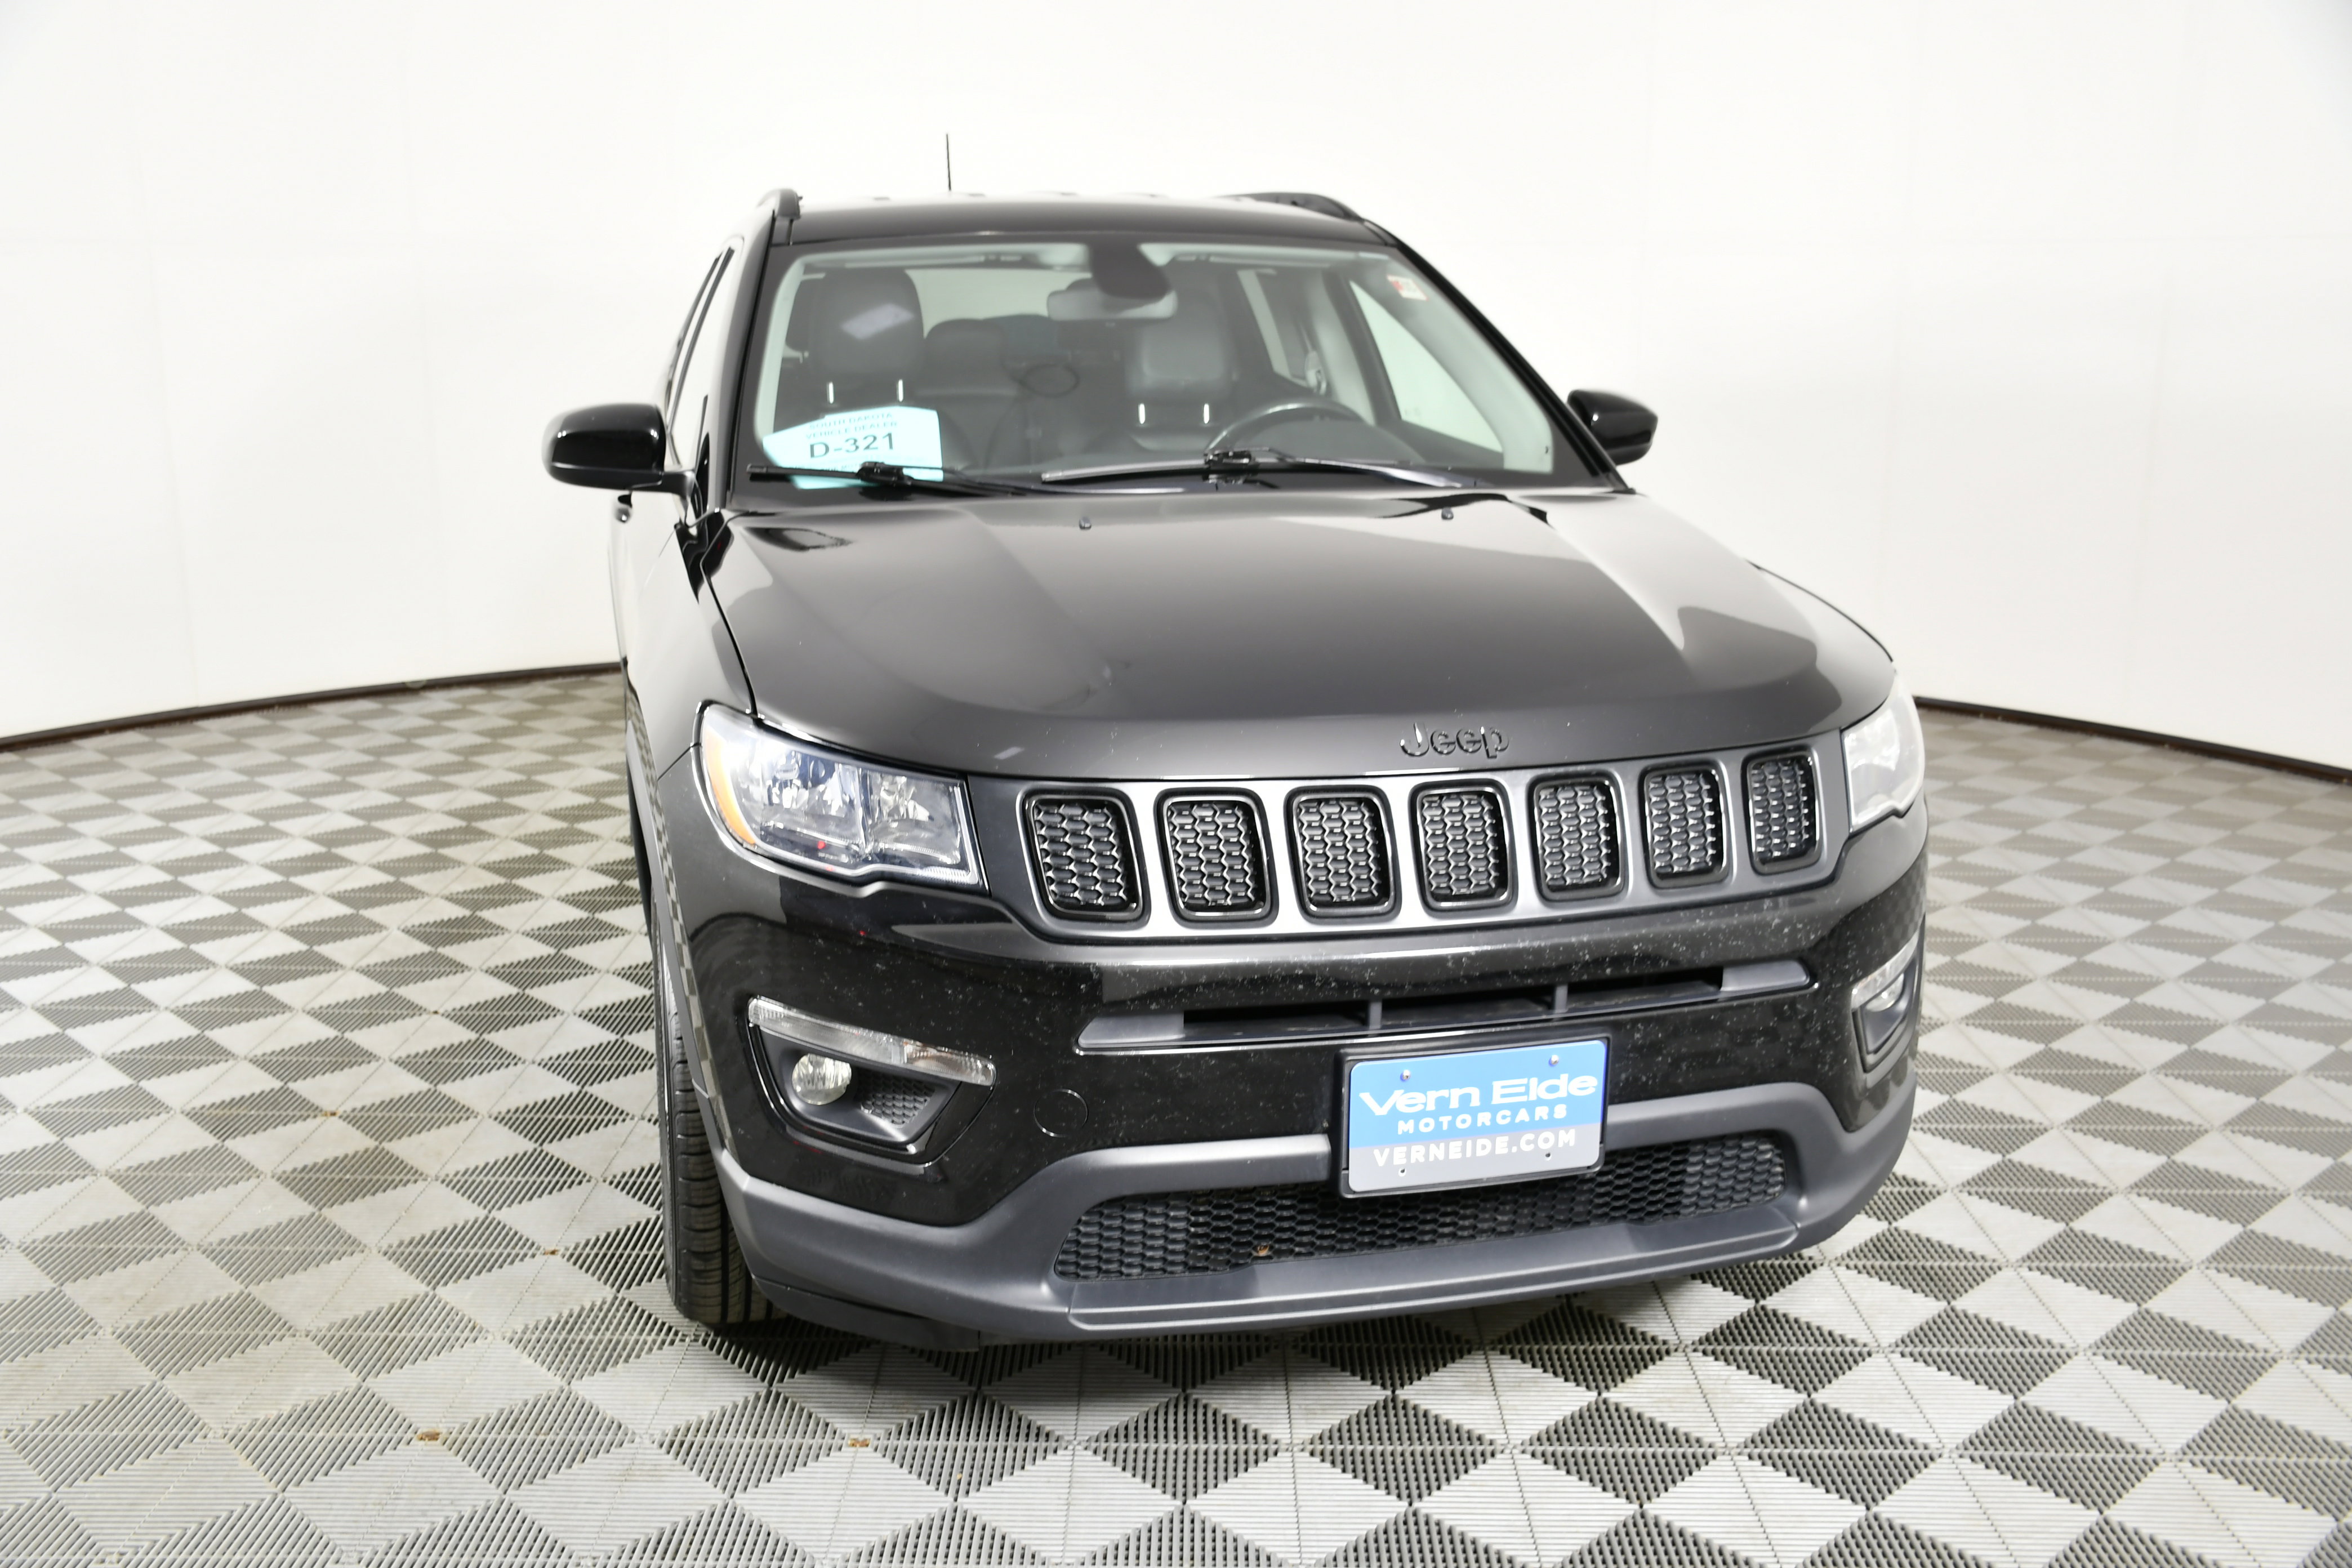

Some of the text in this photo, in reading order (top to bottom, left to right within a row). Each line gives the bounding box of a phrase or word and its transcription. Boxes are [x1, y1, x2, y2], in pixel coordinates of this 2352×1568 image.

[805, 421, 898, 439] VEHICLE DEALER
[809, 418, 846, 430] SOUTH
[809, 431, 894, 459] D-321
[1399, 722, 1509, 759] Jeep
[1359, 1086, 1480, 1116] Vern
[1397, 1104, 1567, 1135] MOTORCARS
[1373, 1129, 1576, 1166] VERNEIDE.COM
